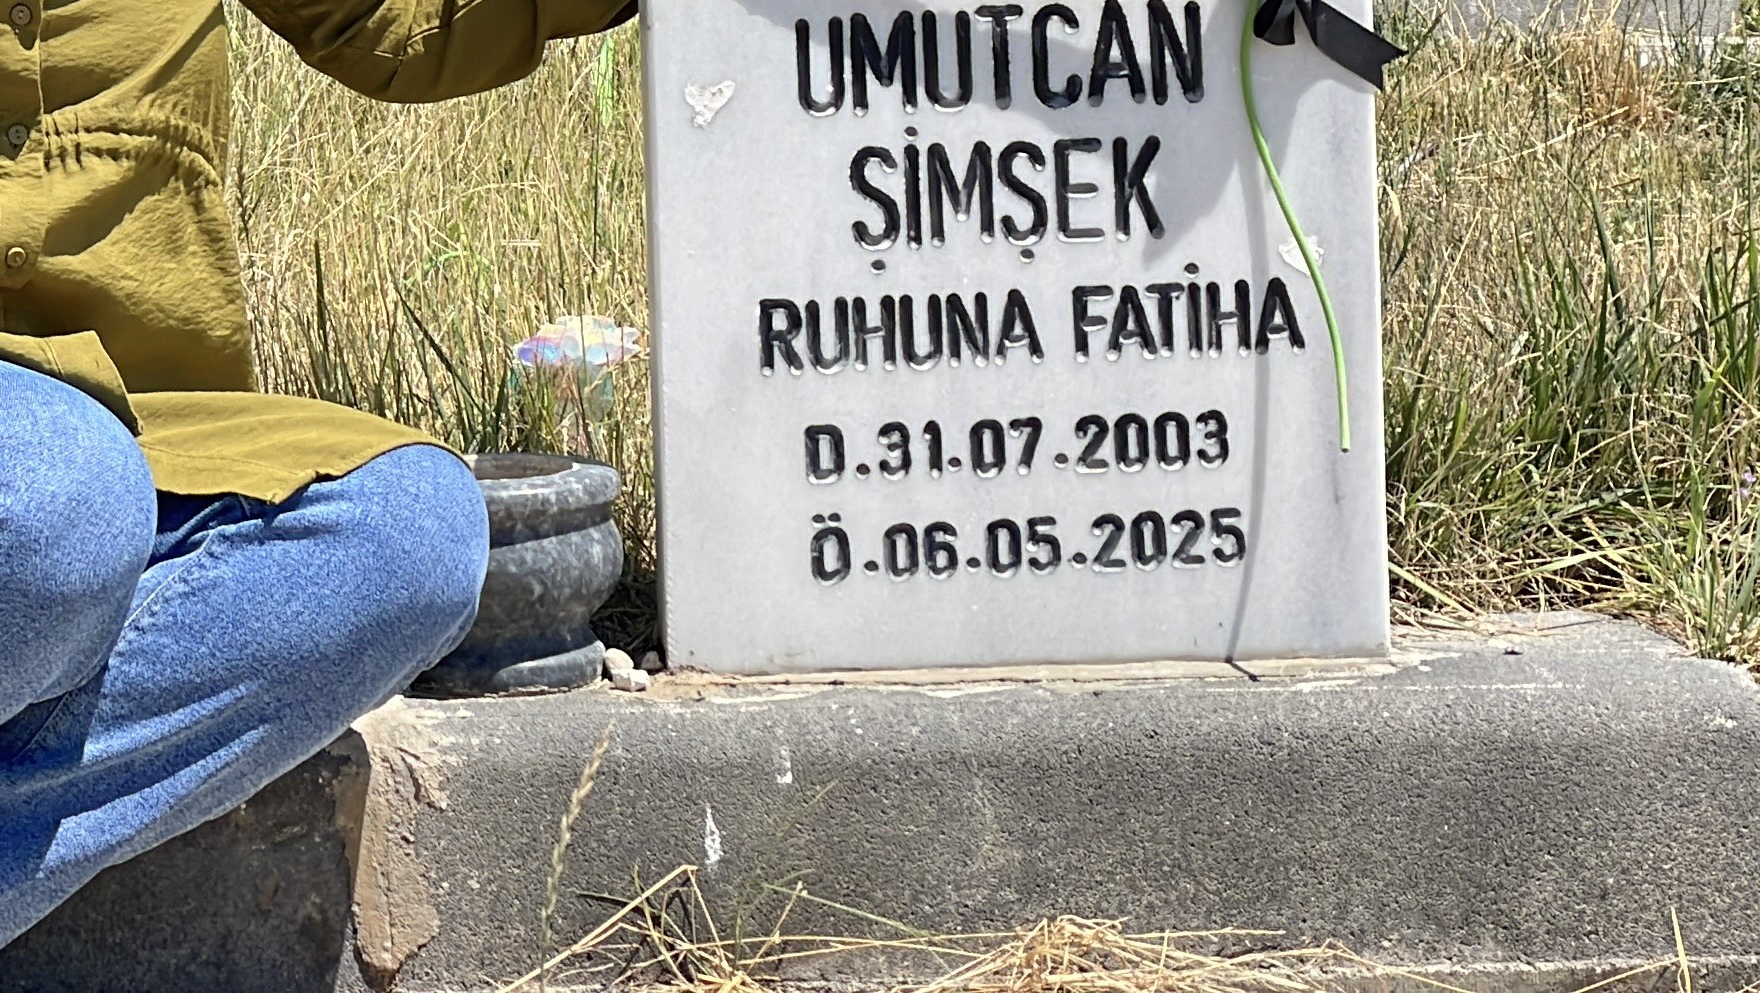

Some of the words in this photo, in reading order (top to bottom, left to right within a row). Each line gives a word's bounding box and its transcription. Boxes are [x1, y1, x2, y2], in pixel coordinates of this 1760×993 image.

[847, 124, 1166, 275] ŞİMŞEK
[756, 287, 1045, 378] RUHUNA
[1071, 261, 1307, 364] FATİHA
[802, 408, 1231, 486] D.31.07.2003
[808, 507, 1249, 586] Ö.06.05.2025
